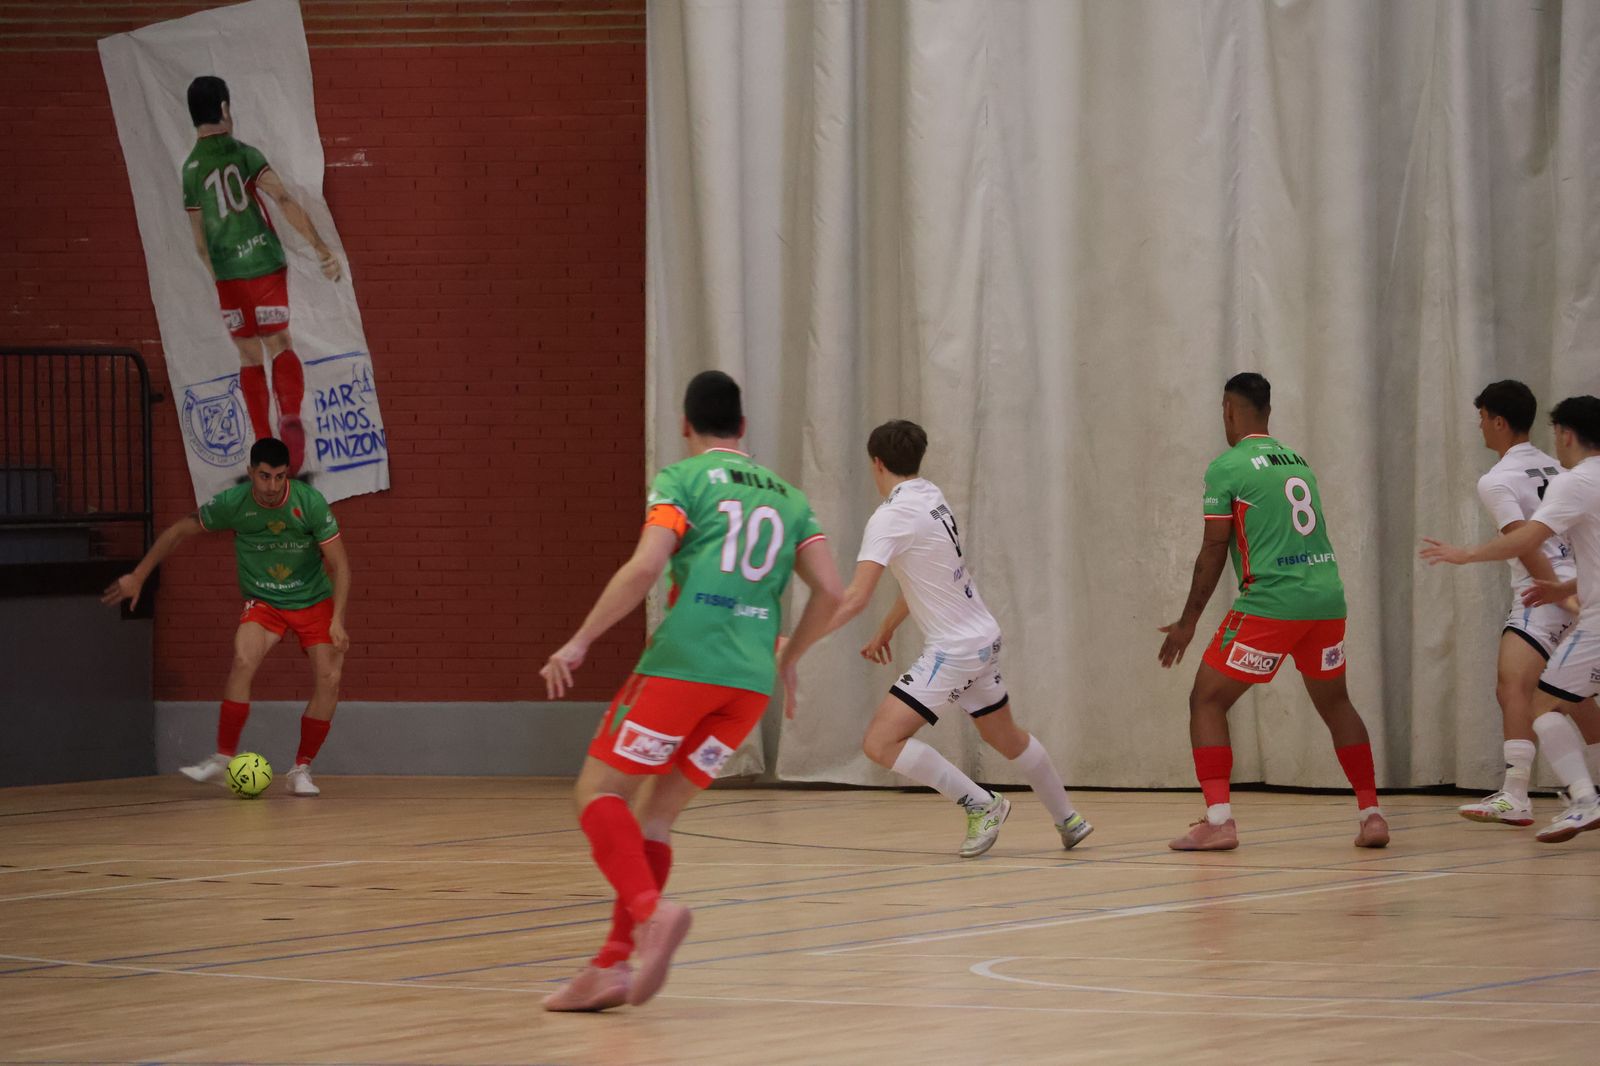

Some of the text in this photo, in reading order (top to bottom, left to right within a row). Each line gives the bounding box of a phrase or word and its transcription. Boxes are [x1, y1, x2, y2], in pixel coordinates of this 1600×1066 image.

[203, 163, 249, 219] 10
[314, 383, 356, 413] BAR
[1284, 476, 1317, 536] 8
[717, 500, 785, 582] 10
